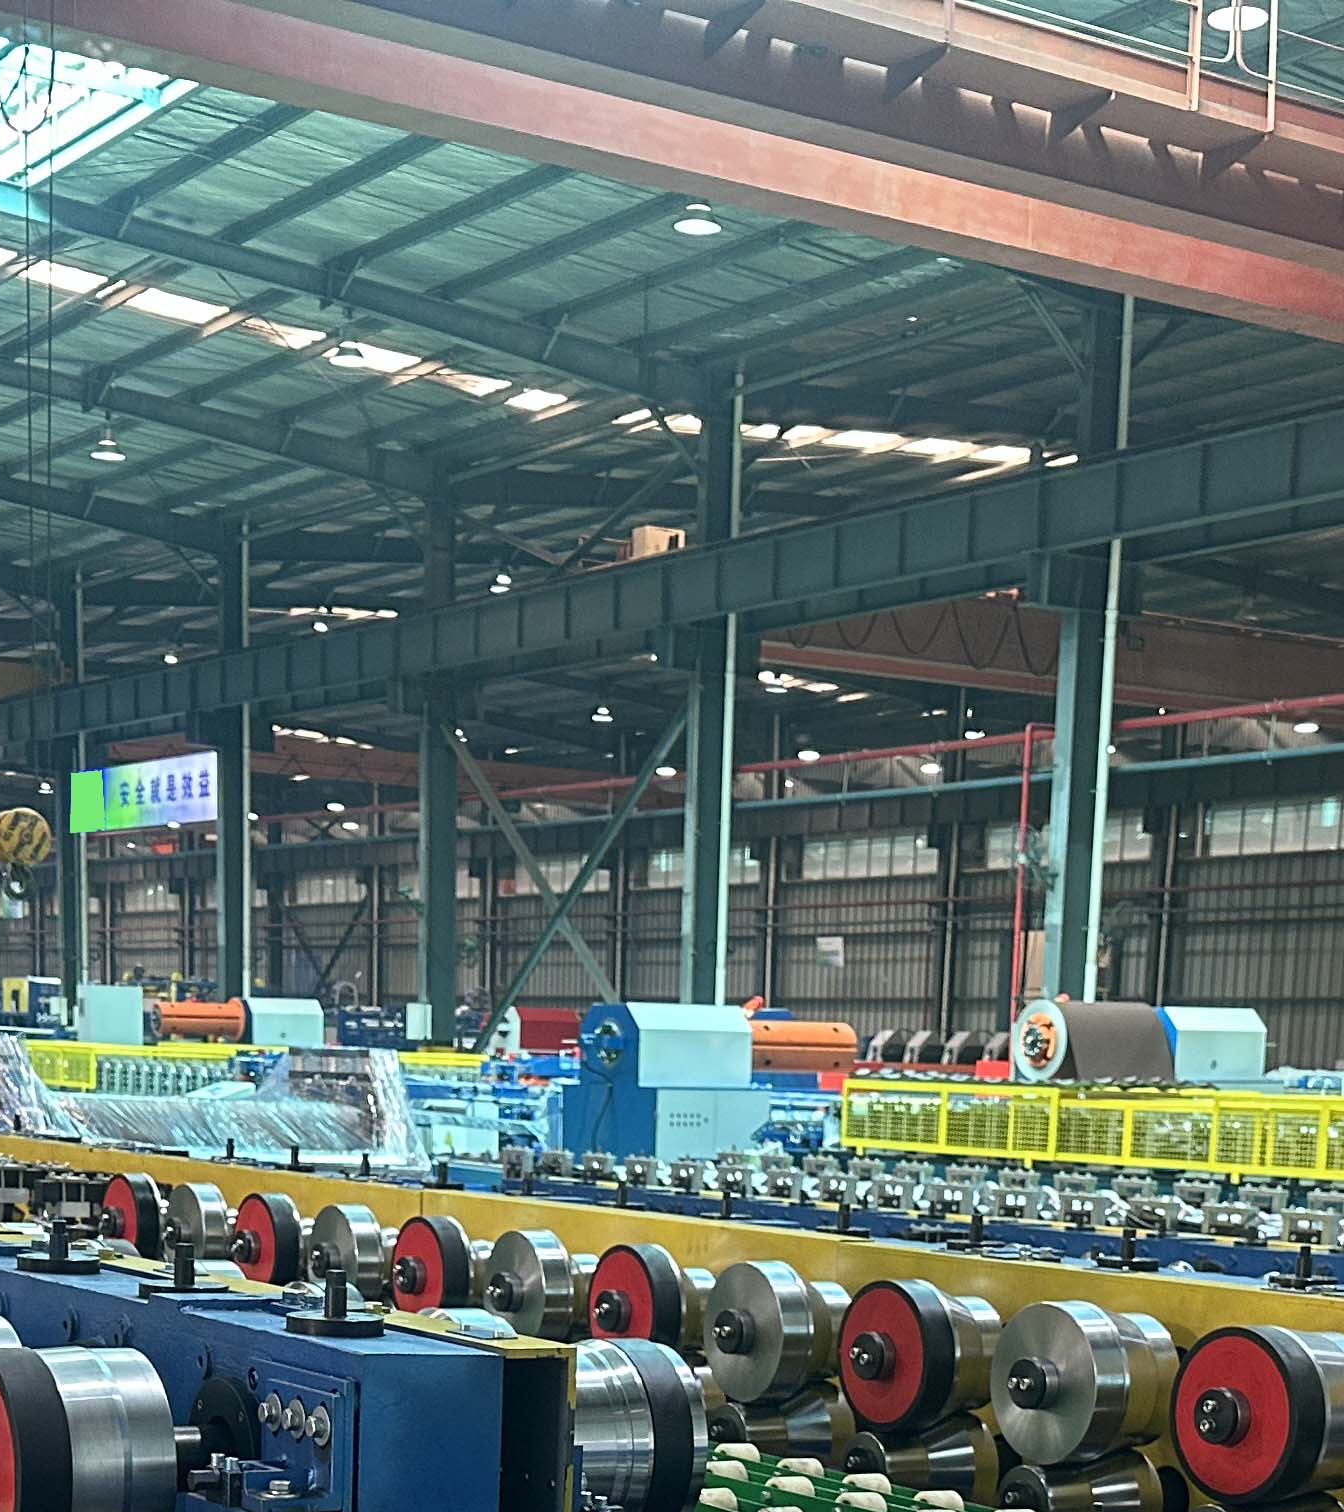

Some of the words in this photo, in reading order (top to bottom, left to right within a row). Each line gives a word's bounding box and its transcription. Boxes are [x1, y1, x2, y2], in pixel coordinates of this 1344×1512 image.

[119, 769, 211, 807] 安全就是效益
